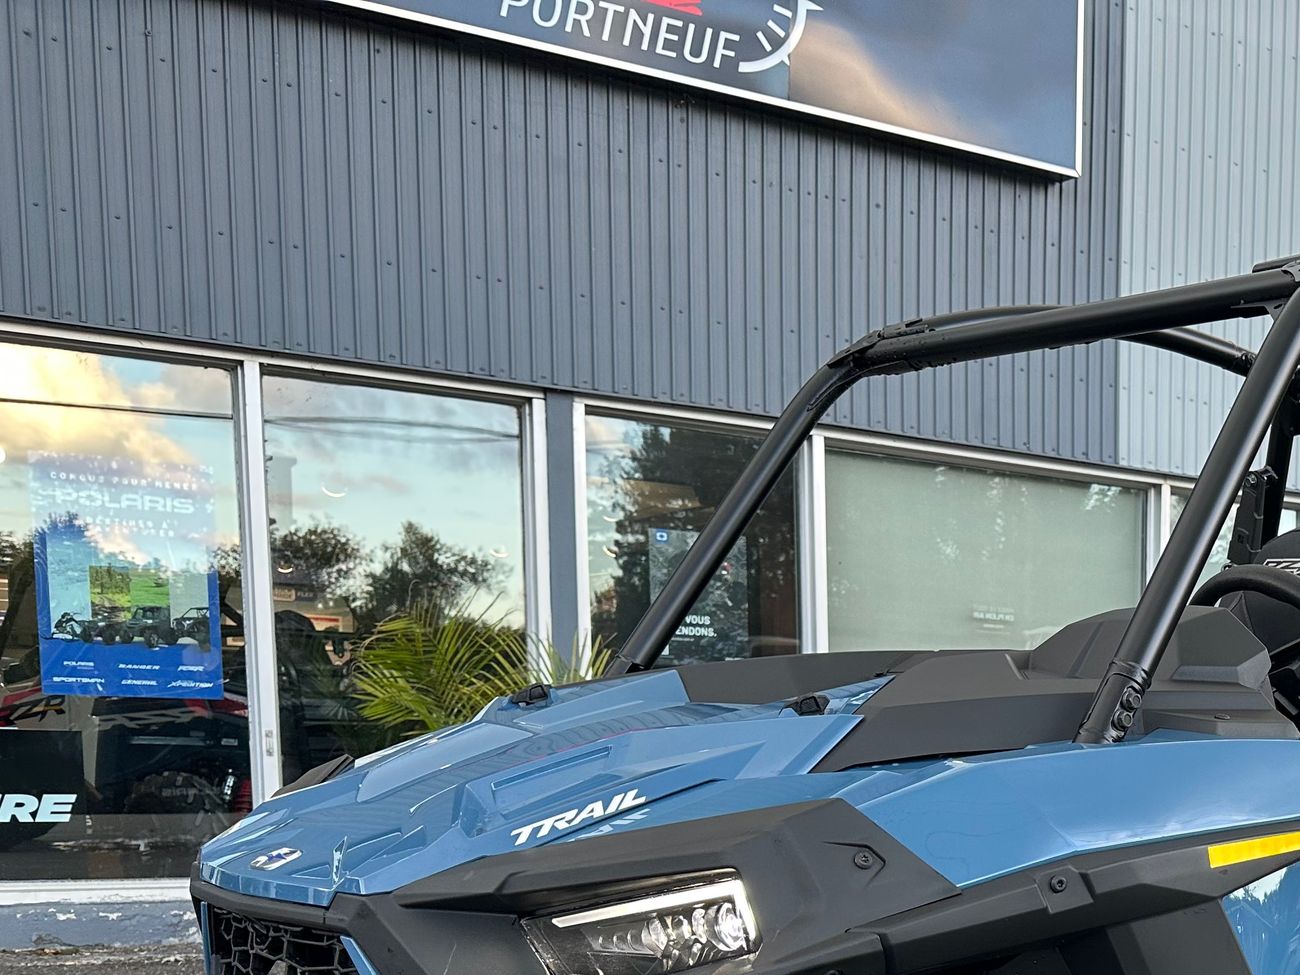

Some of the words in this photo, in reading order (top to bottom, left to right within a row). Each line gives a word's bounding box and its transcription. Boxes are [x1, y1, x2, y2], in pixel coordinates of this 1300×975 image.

[54, 487, 195, 513] POLARIS
[676, 626, 718, 637] ENDONS.
[685, 614, 711, 625] VOUS
[0, 794, 77, 822] RE
[510, 789, 646, 846] TRAIL
